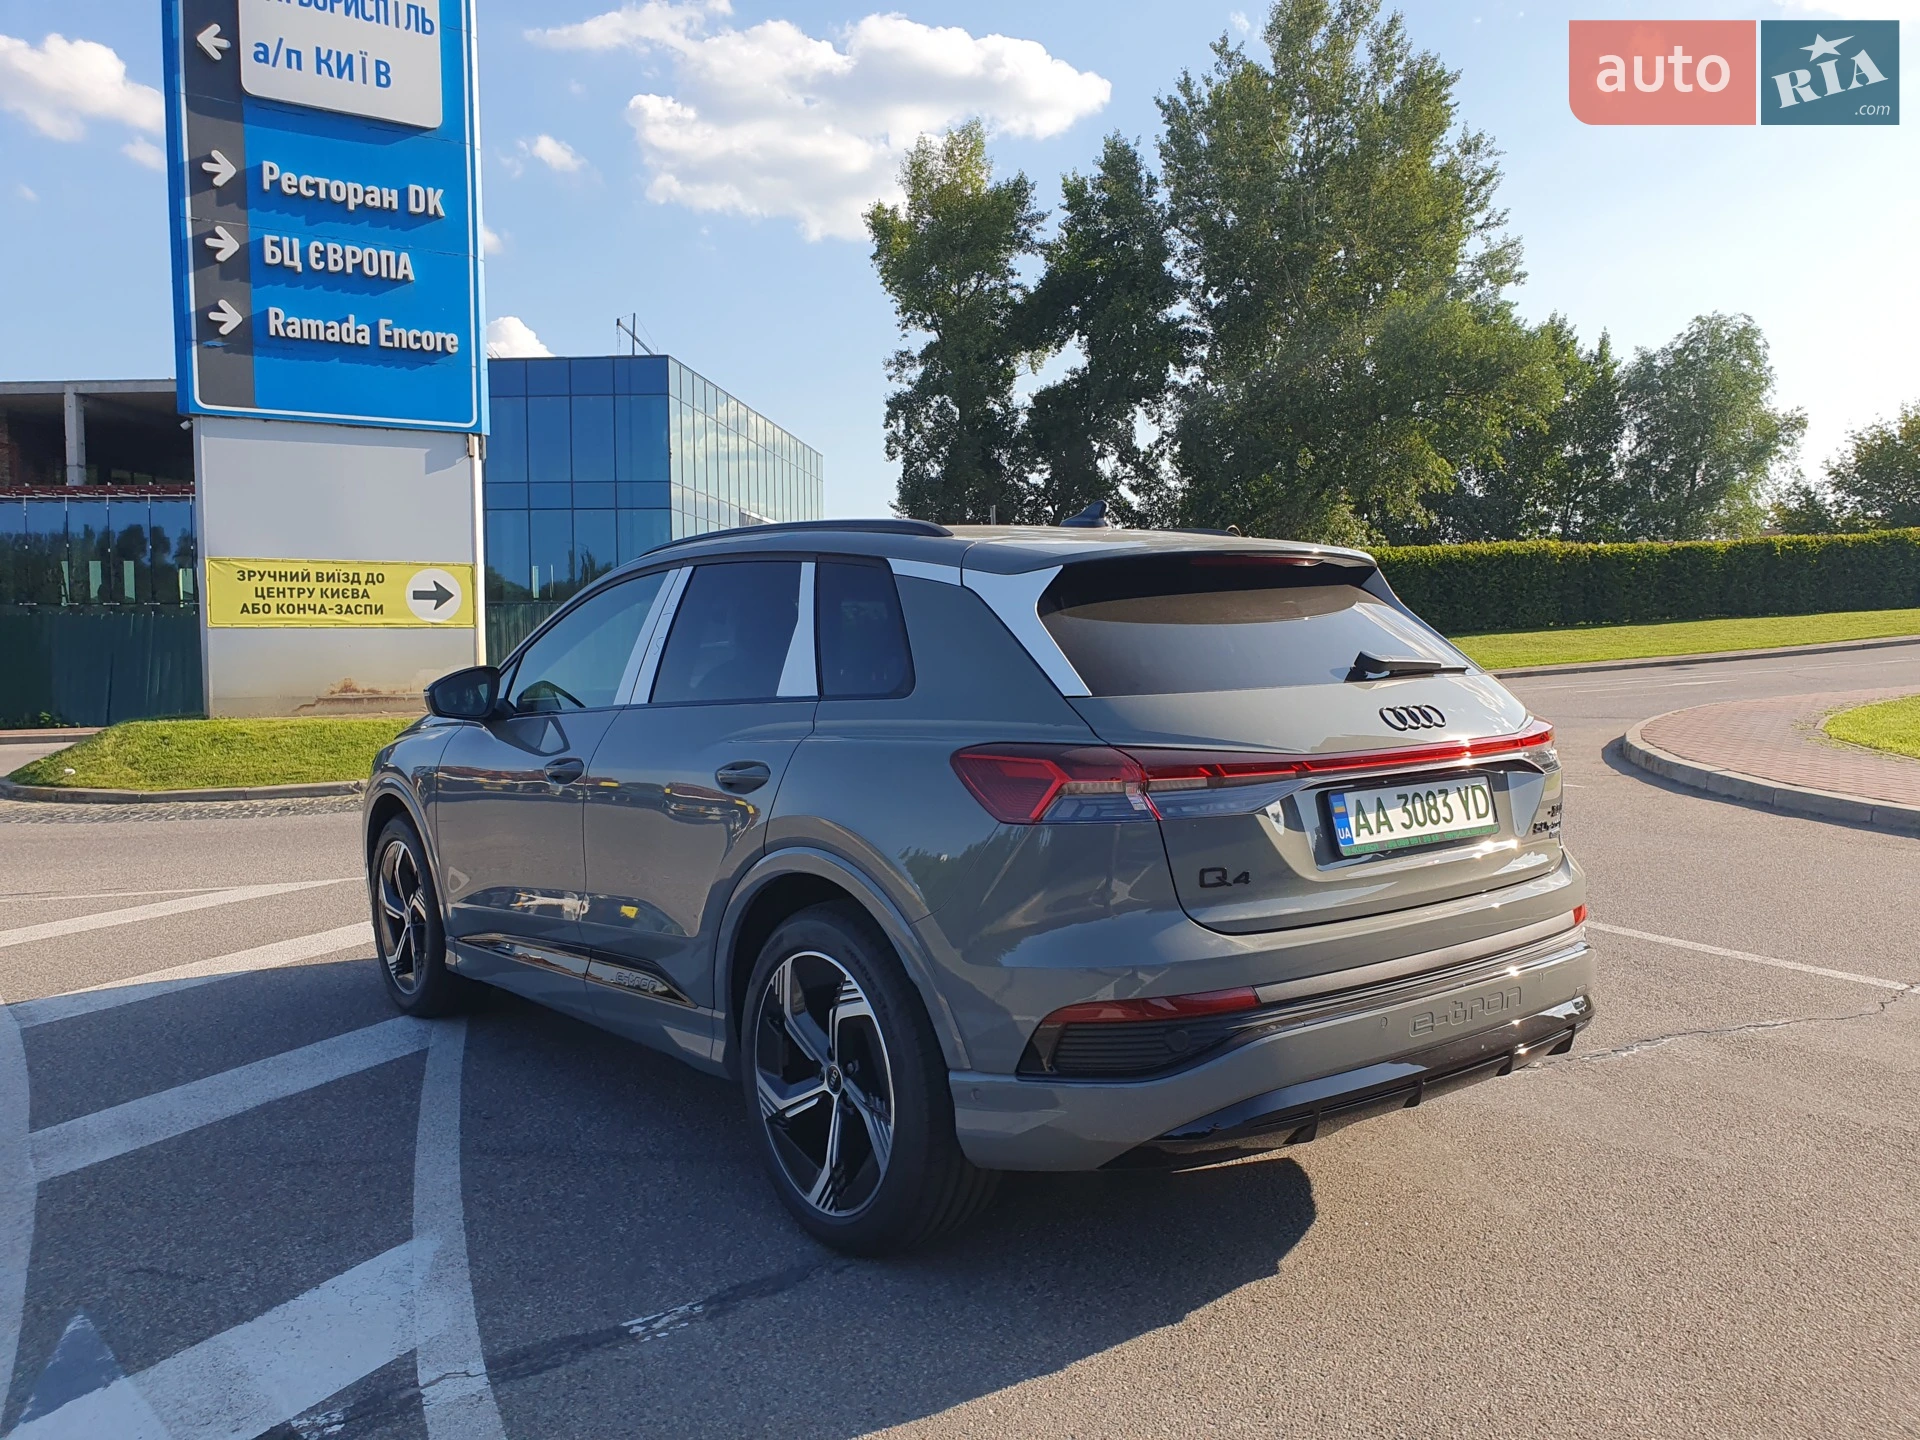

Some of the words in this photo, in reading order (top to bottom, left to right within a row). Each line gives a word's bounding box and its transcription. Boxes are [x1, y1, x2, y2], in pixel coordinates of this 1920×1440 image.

[253, 37, 303, 71] а/п
[315, 46, 392, 89] КИЇВ
[262, 160, 399, 212] Ресторан
[407, 184, 446, 218] DK
[263, 234, 302, 273] БЦ
[308, 241, 416, 282] ЄВРОПА
[267, 306, 371, 346] Ramada
[378, 318, 460, 354] Encore
[236, 568, 311, 583] ЗРУЧНИЙ
[315, 569, 362, 586] ВИЇЗД
[365, 572, 386, 586] ДО
[254, 586, 316, 600] ЦЕНТРУ
[320, 588, 371, 600] КИЄВА
[240, 603, 272, 615] АБО
[275, 603, 385, 616] КОНЧА-ЗАСПИ
[1337, 826, 1352, 840] UA
[1354, 796, 1395, 838] AA
[1396, 788, 1455, 830] 3083
[1456, 784, 1490, 821] YD
[1408, 985, 1523, 1038] e-tron
